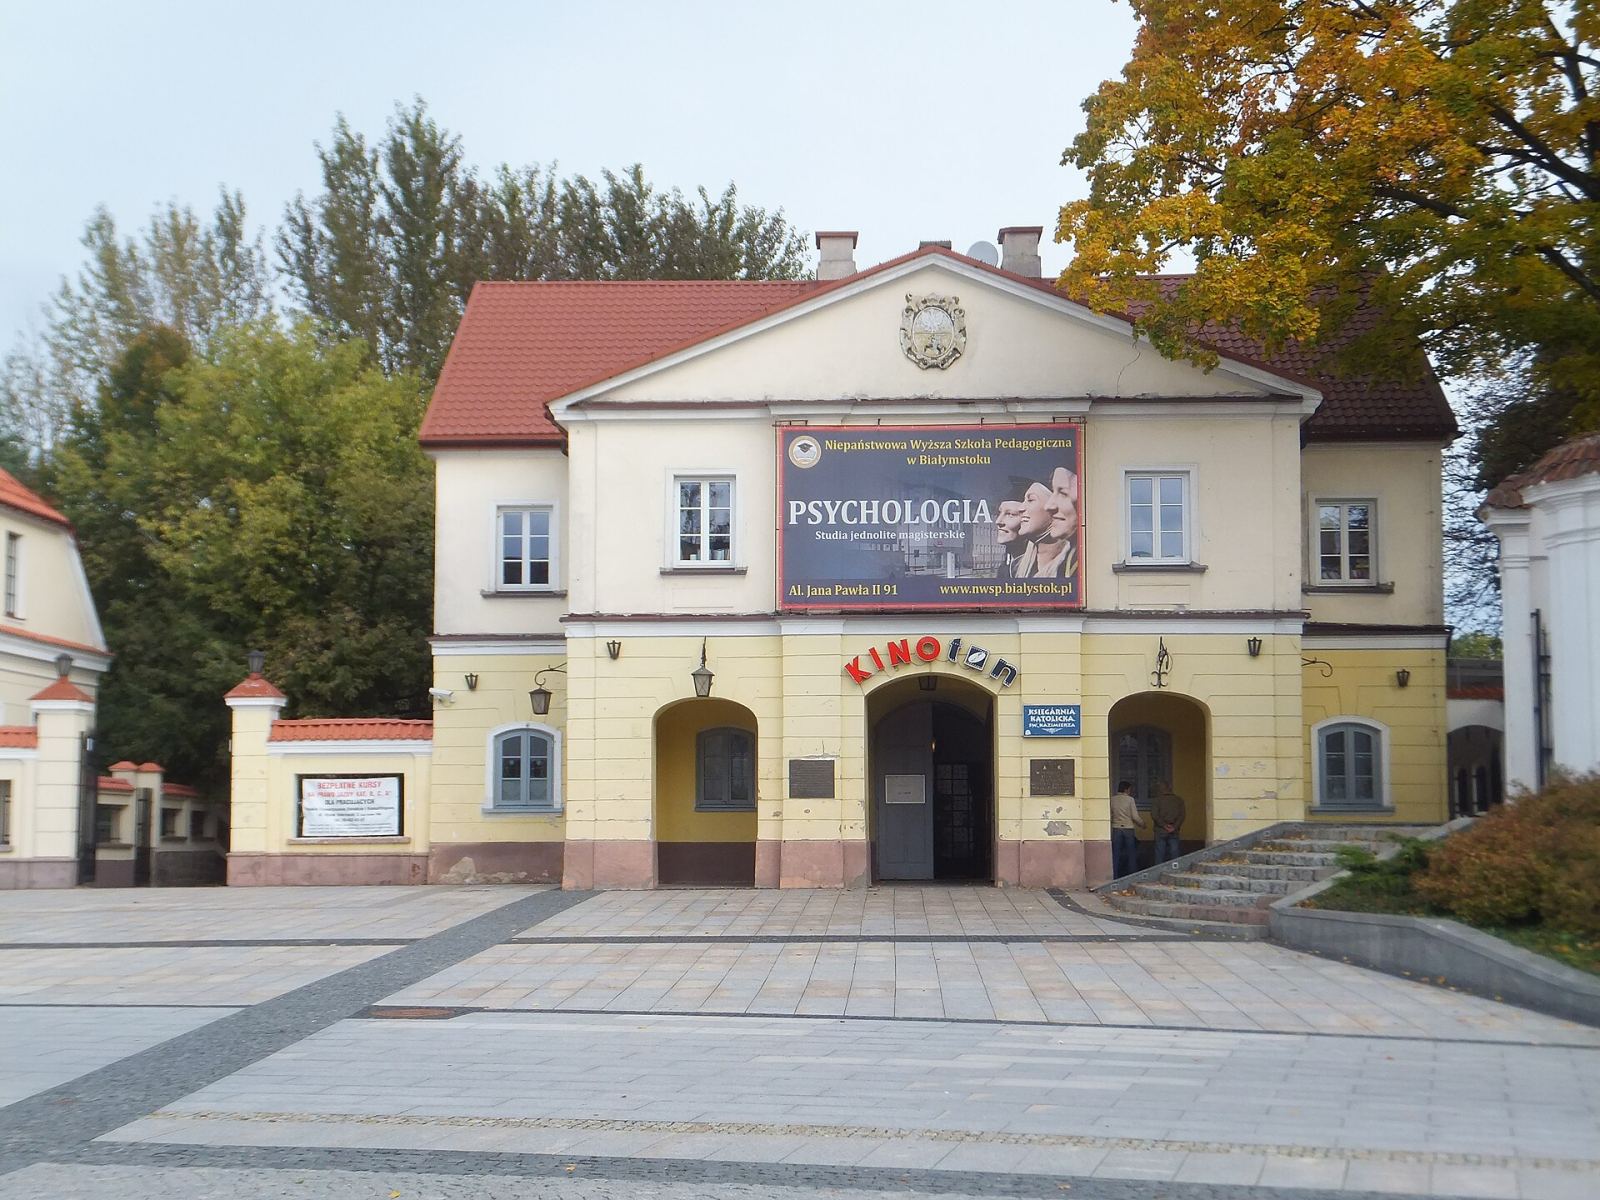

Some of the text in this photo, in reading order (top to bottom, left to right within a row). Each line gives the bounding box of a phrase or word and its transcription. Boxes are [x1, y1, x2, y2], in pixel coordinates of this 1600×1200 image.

[825, 437, 1072, 453] Niepaństwowa Wyższa Szkoła Pedagogiczna
[906, 454, 991, 468] w Białymstoku
[788, 499, 993, 525] PSYCHOLOGIA
[815, 529, 966, 542] Studia jednolite magisterskie
[788, 584, 898, 598] Al. Jana Pawła II 91
[939, 582, 1072, 597] www.nwsp.bialystok.pl
[843, 635, 941, 685] KINO
